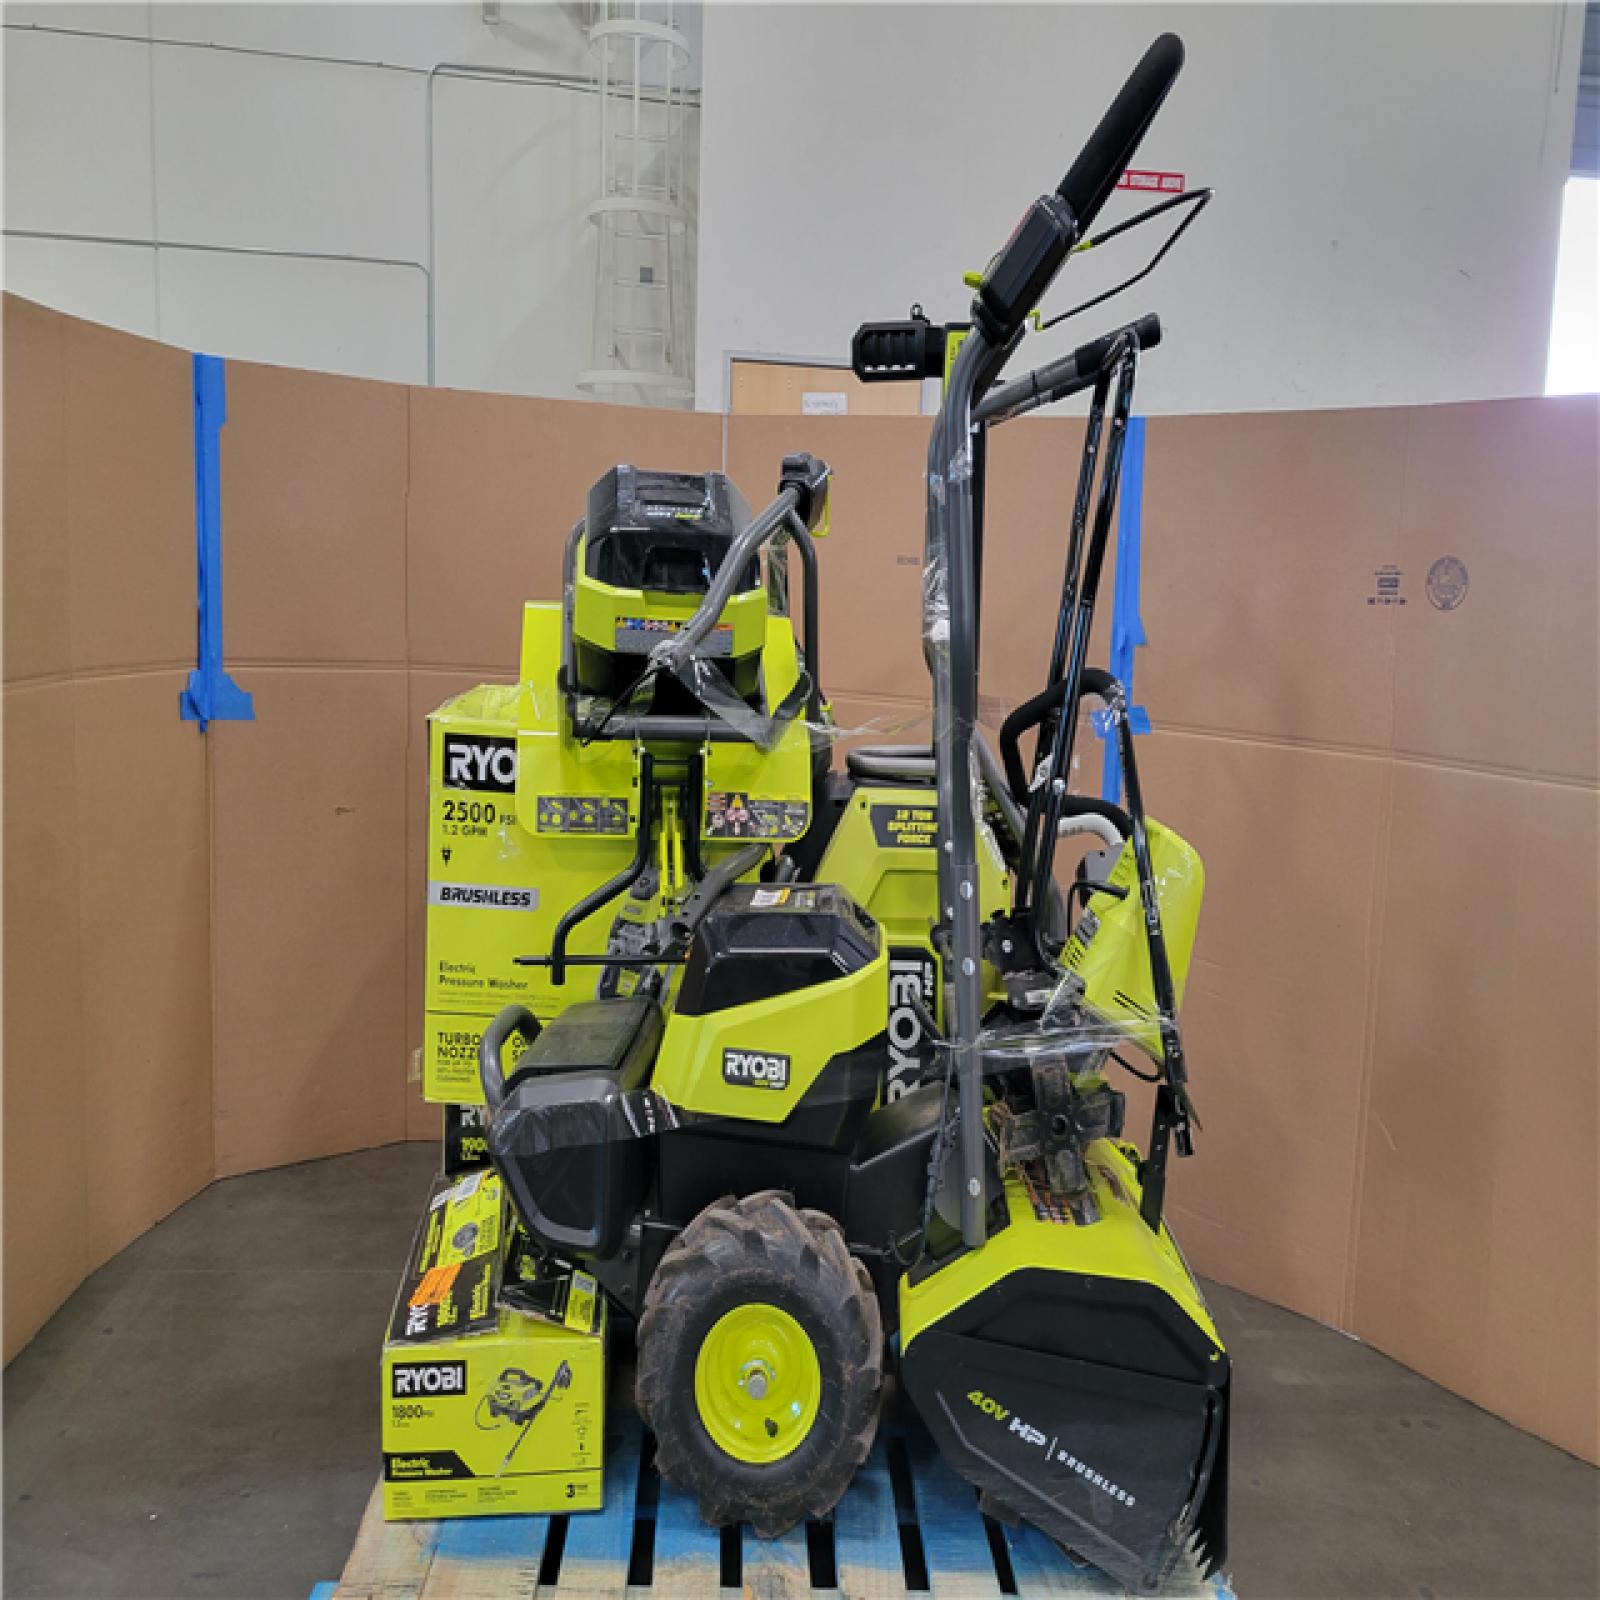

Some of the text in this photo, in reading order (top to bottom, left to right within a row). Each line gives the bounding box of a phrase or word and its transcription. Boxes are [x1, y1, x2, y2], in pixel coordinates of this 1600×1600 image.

[442, 800, 496, 823] 2500
[440, 886, 531, 907] BRUSHLESS
[439, 974, 528, 990] Pressure Washer
[724, 1052, 786, 1081] RYOBI
[394, 1366, 463, 1393] RYOBI
[967, 1390, 1011, 1421] 40V
[1009, 1416, 1047, 1446] HP
[565, 1484, 576, 1498] 3
